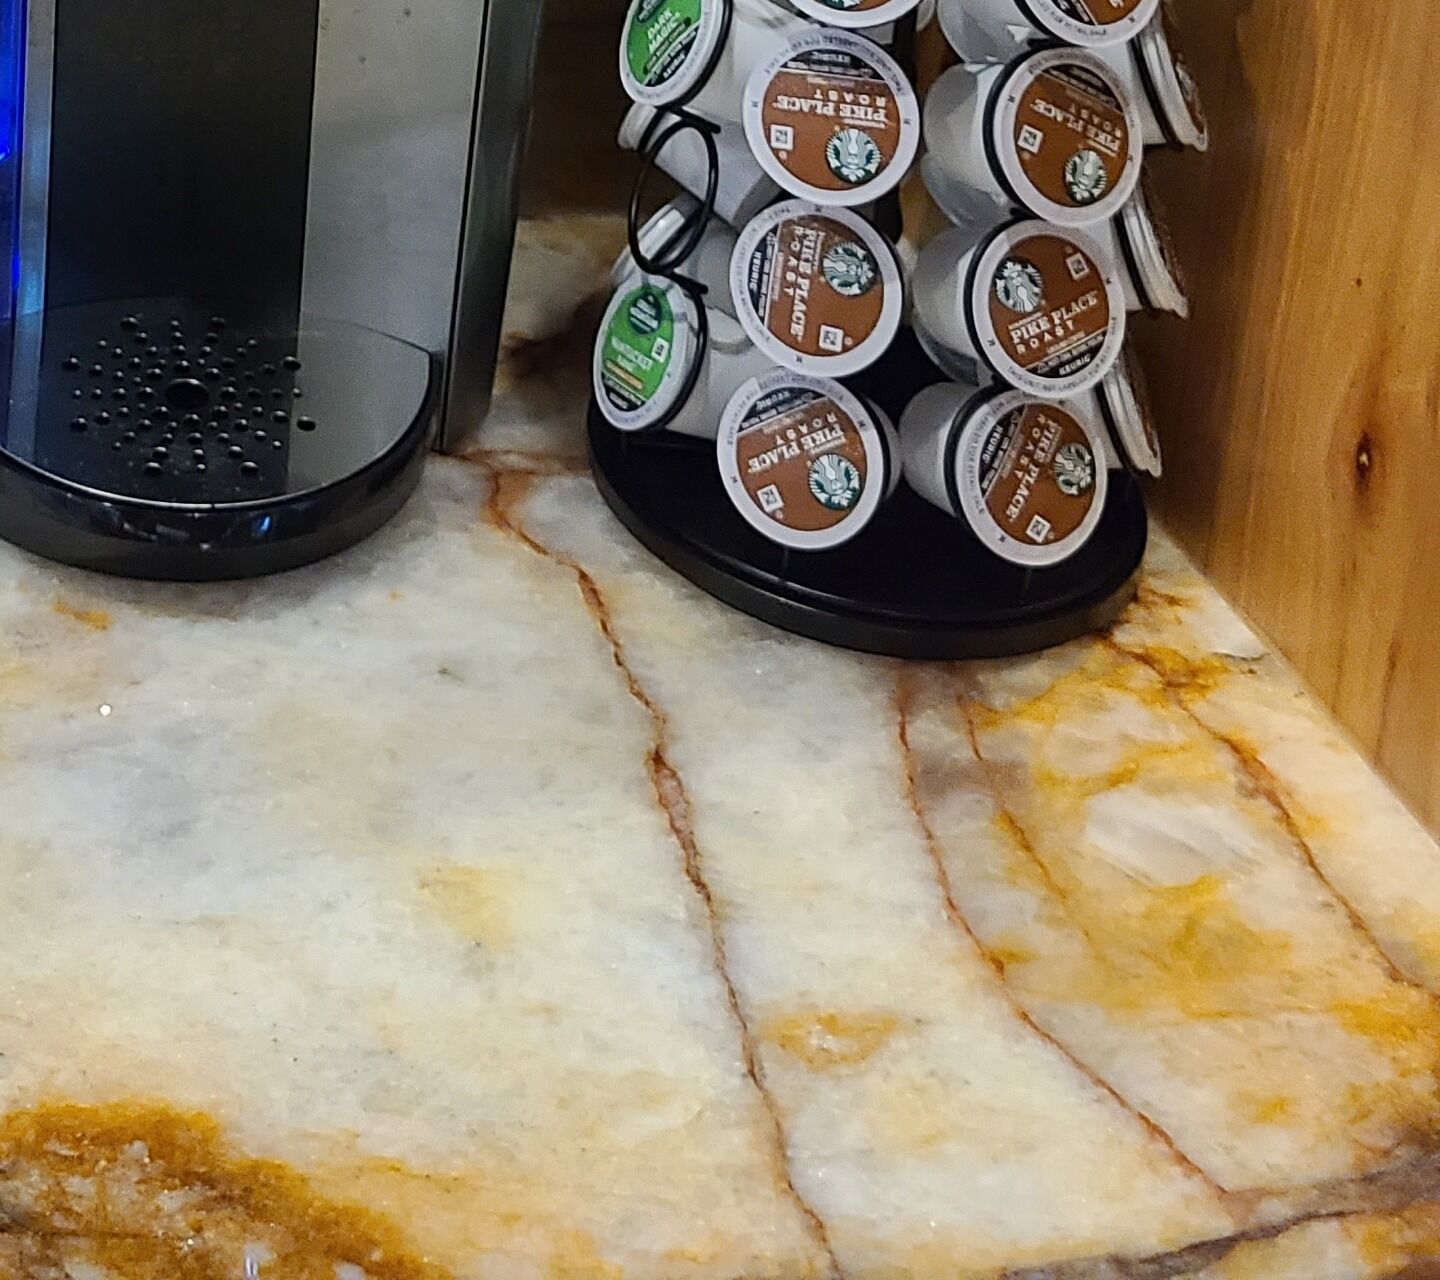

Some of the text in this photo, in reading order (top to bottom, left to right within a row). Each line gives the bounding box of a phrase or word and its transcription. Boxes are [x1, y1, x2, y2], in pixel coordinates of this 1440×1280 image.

[647, 7, 672, 40] DARK
[772, 95, 888, 122] PIKE PLACE
[813, 88, 887, 109] ROAST
[789, 227, 817, 339] PIKE PLACE
[1010, 314, 1052, 345] PIKE
[1050, 291, 1099, 326] PLACE
[1015, 319, 1075, 355] ROAST
[775, 411, 839, 446] ROAST
[800, 423, 846, 451] PIKE
[747, 440, 801, 474] PLACE
[1005, 418, 1061, 520] PIKE PLACE
